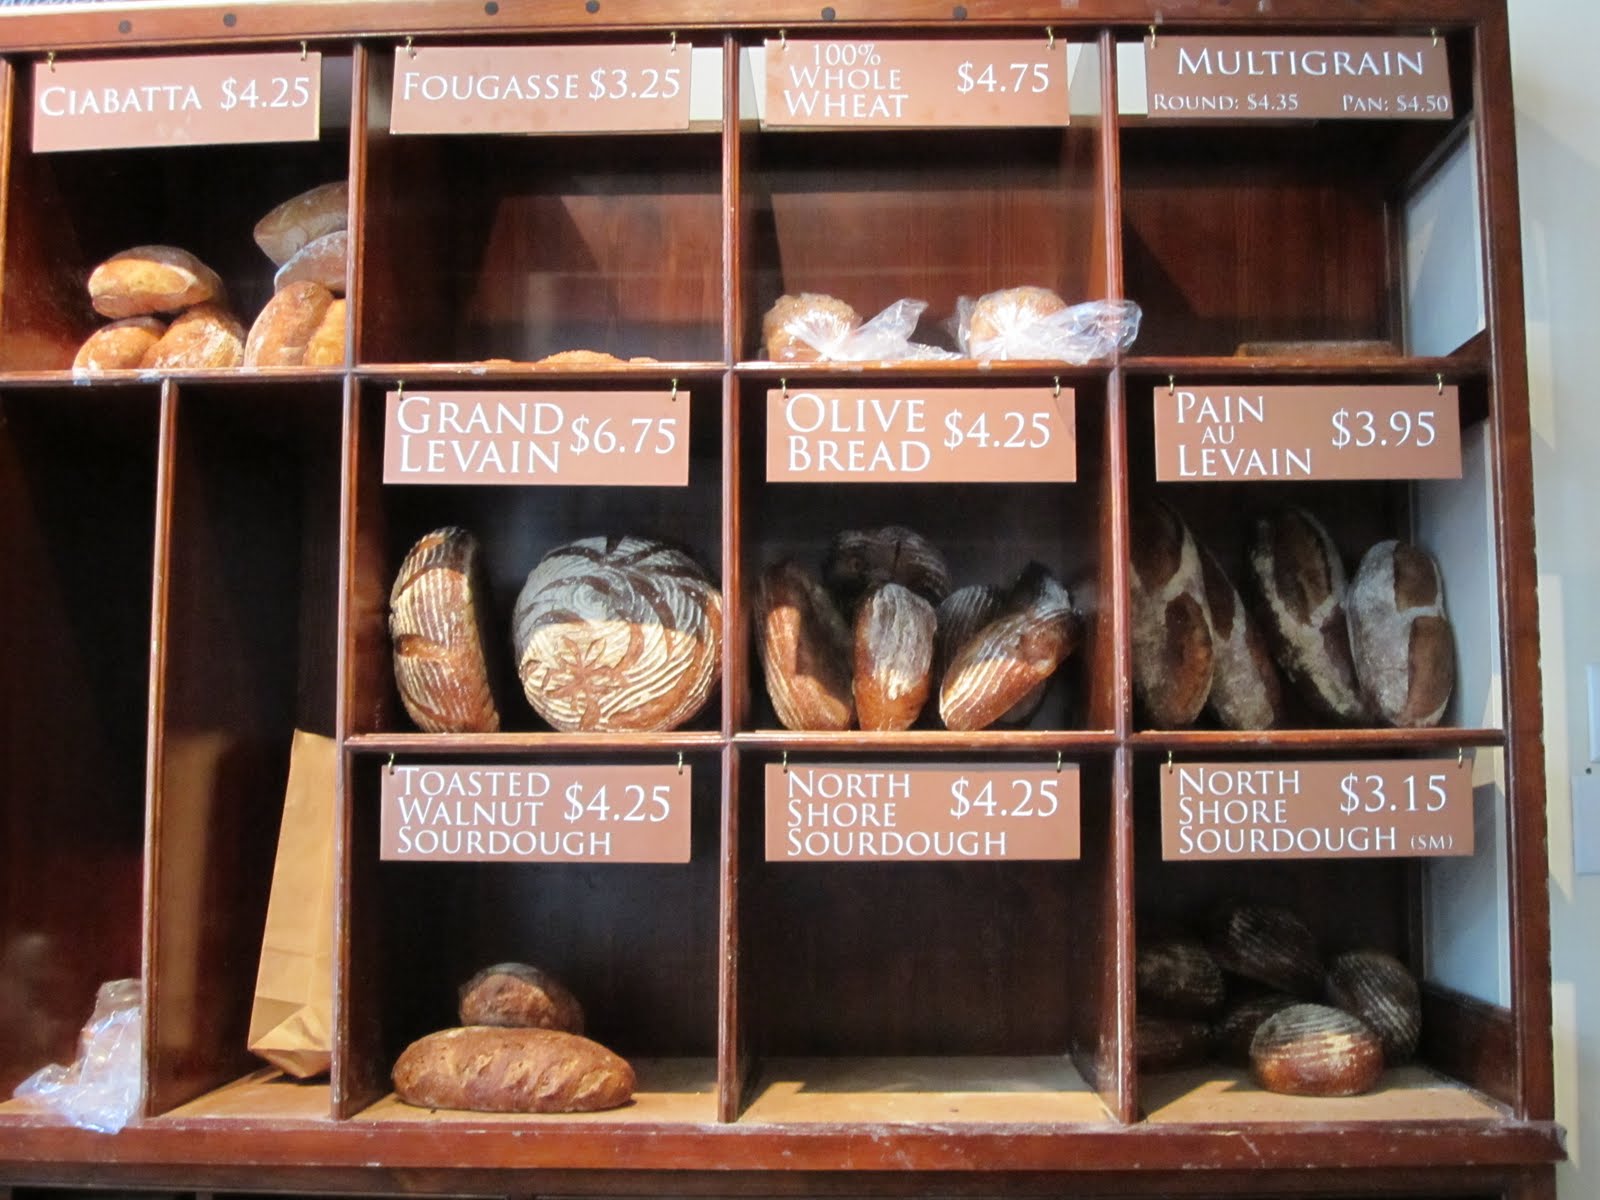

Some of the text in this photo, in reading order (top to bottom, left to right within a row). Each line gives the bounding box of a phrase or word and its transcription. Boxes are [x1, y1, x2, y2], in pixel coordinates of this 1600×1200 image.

[813, 43, 881, 66] 100%
[1177, 47, 1423, 76] MULTIGRAIN
[403, 67, 681, 102] FOUGASSE $3.25
[789, 66, 902, 90] WHOLE
[957, 60, 1049, 95] $4.75
[38, 76, 310, 117] CIABATTA $4.25
[783, 90, 909, 118] WHEAT
[1154, 93, 1299, 111] ROUND: $4.35
[1342, 94, 1449, 113] PAN: $4.50
[397, 396, 564, 434] GRAND
[785, 392, 926, 433] OLIVE
[1176, 391, 1264, 424] PAIN
[569, 414, 676, 456] $6.75
[943, 408, 1050, 451] $4.25
[1201, 425, 1236, 445] AU
[1331, 407, 1435, 450] $3.95
[399, 435, 561, 473] LEVAIN
[788, 435, 931, 472] BREAD
[1178, 443, 1312, 477] LEVAIN
[396, 766, 551, 797] TOASTED
[788, 769, 910, 799] NORTH
[1179, 767, 1300, 796] NORTH
[1340, 772, 1446, 816] $3.15
[397, 796, 544, 825] WALNUT
[563, 781, 670, 824] $4.25
[787, 798, 897, 827] SHORE
[949, 776, 1058, 820] $4.25
[1179, 797, 1287, 825] SHORE
[397, 825, 611, 856] SOURDOUGH
[787, 827, 1006, 857] SOURDOUGH
[1179, 825, 1453, 854] SOURDOUGH (SM)
